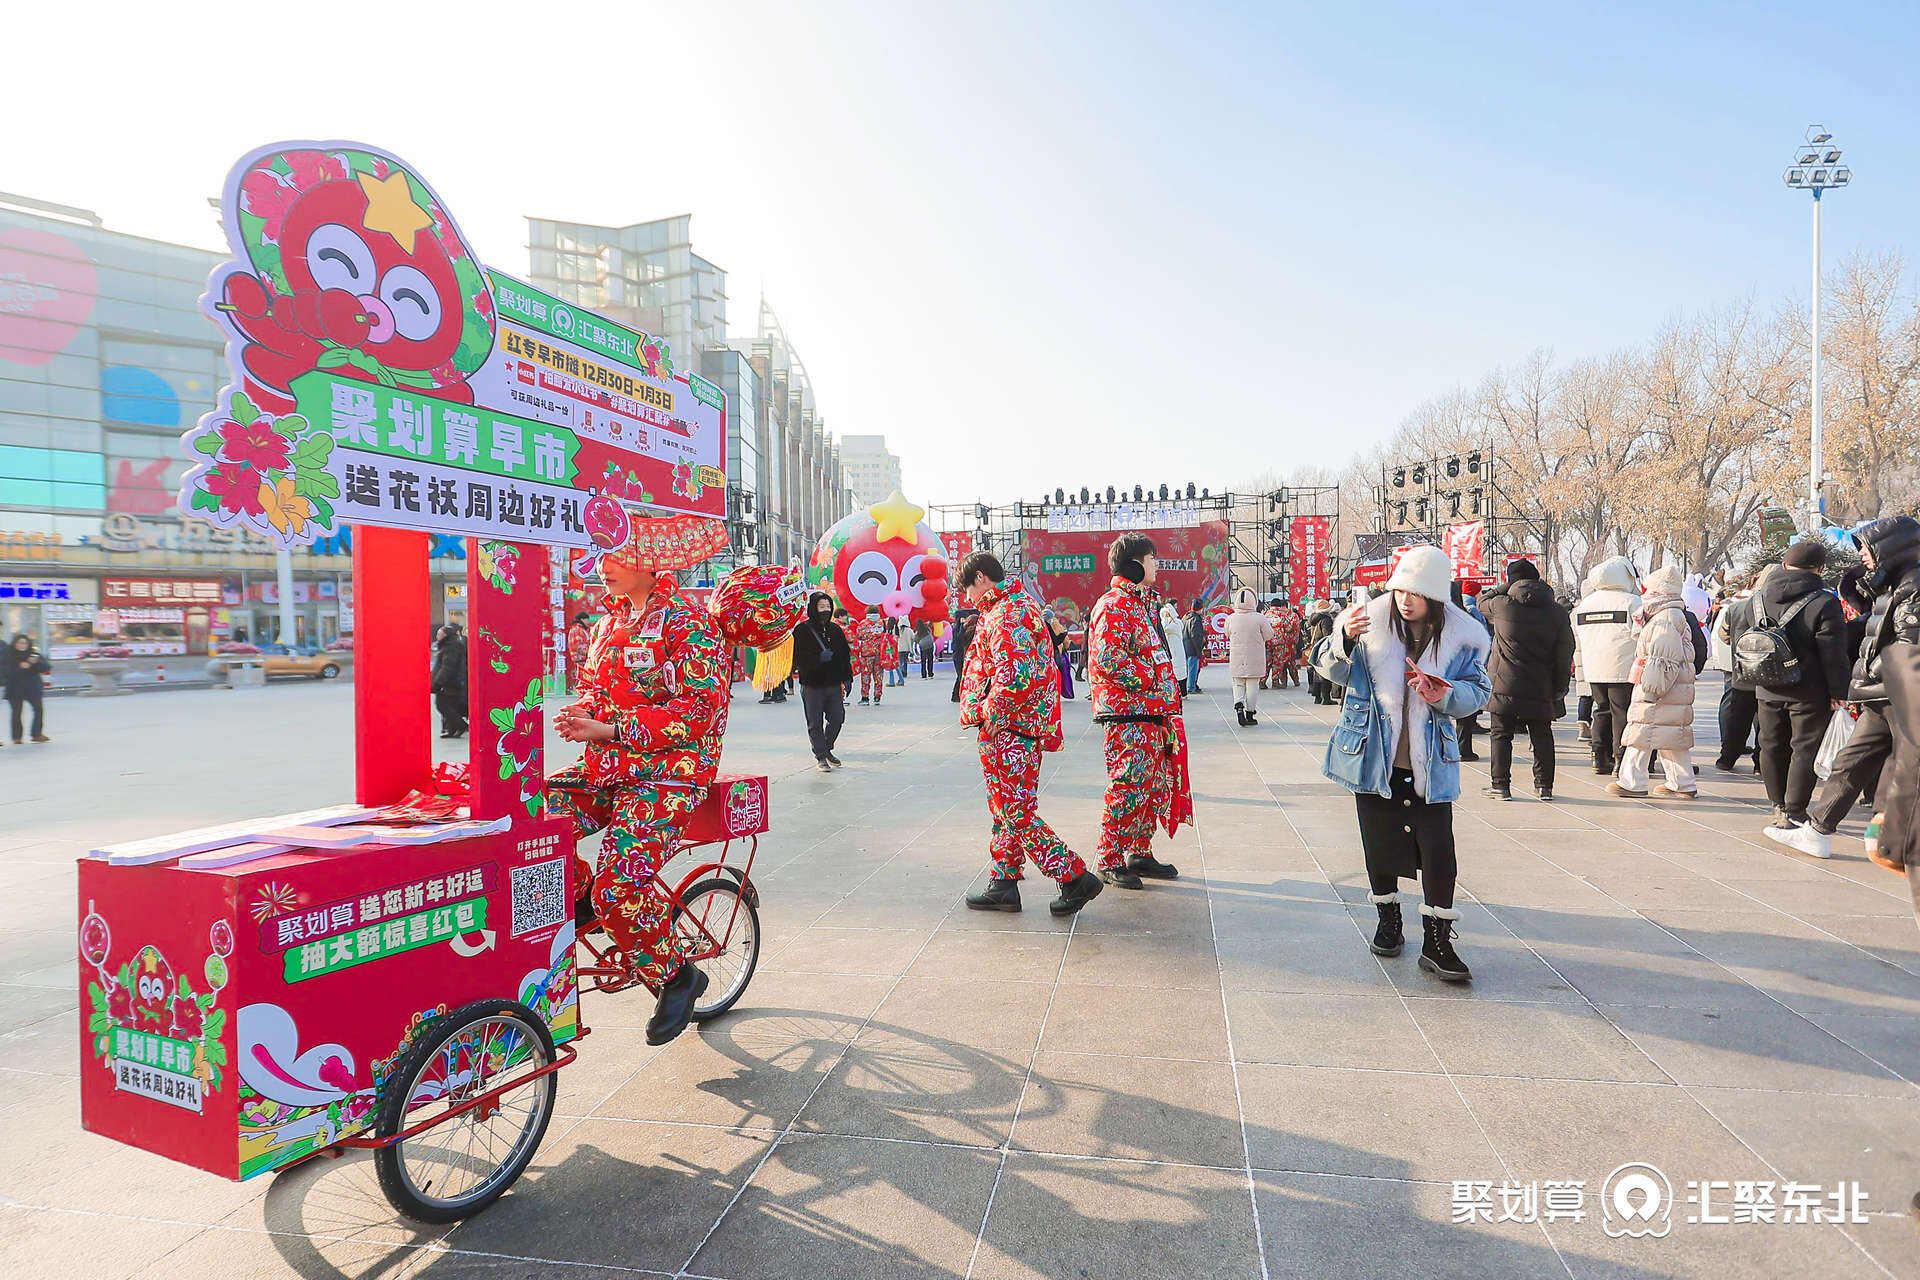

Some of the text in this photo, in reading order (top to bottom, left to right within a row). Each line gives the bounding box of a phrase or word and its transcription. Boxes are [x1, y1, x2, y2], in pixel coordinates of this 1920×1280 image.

[499, 286, 634, 358] 聚划算 汇聚东北
[510, 389, 569, 416] 可获周边礼品一份
[582, 362, 672, 411] 12月30日-1月3日
[330, 382, 567, 480] 聚划算早市
[346, 463, 585, 534] 送花袄周边好礼
[277, 868, 484, 946] 聚划算 送您新年好运
[301, 903, 475, 974] 抽大额惊喜红包
[116, 1029, 191, 1073] 聚划算早市
[120, 1065, 198, 1105] 送花袄周边好礼
